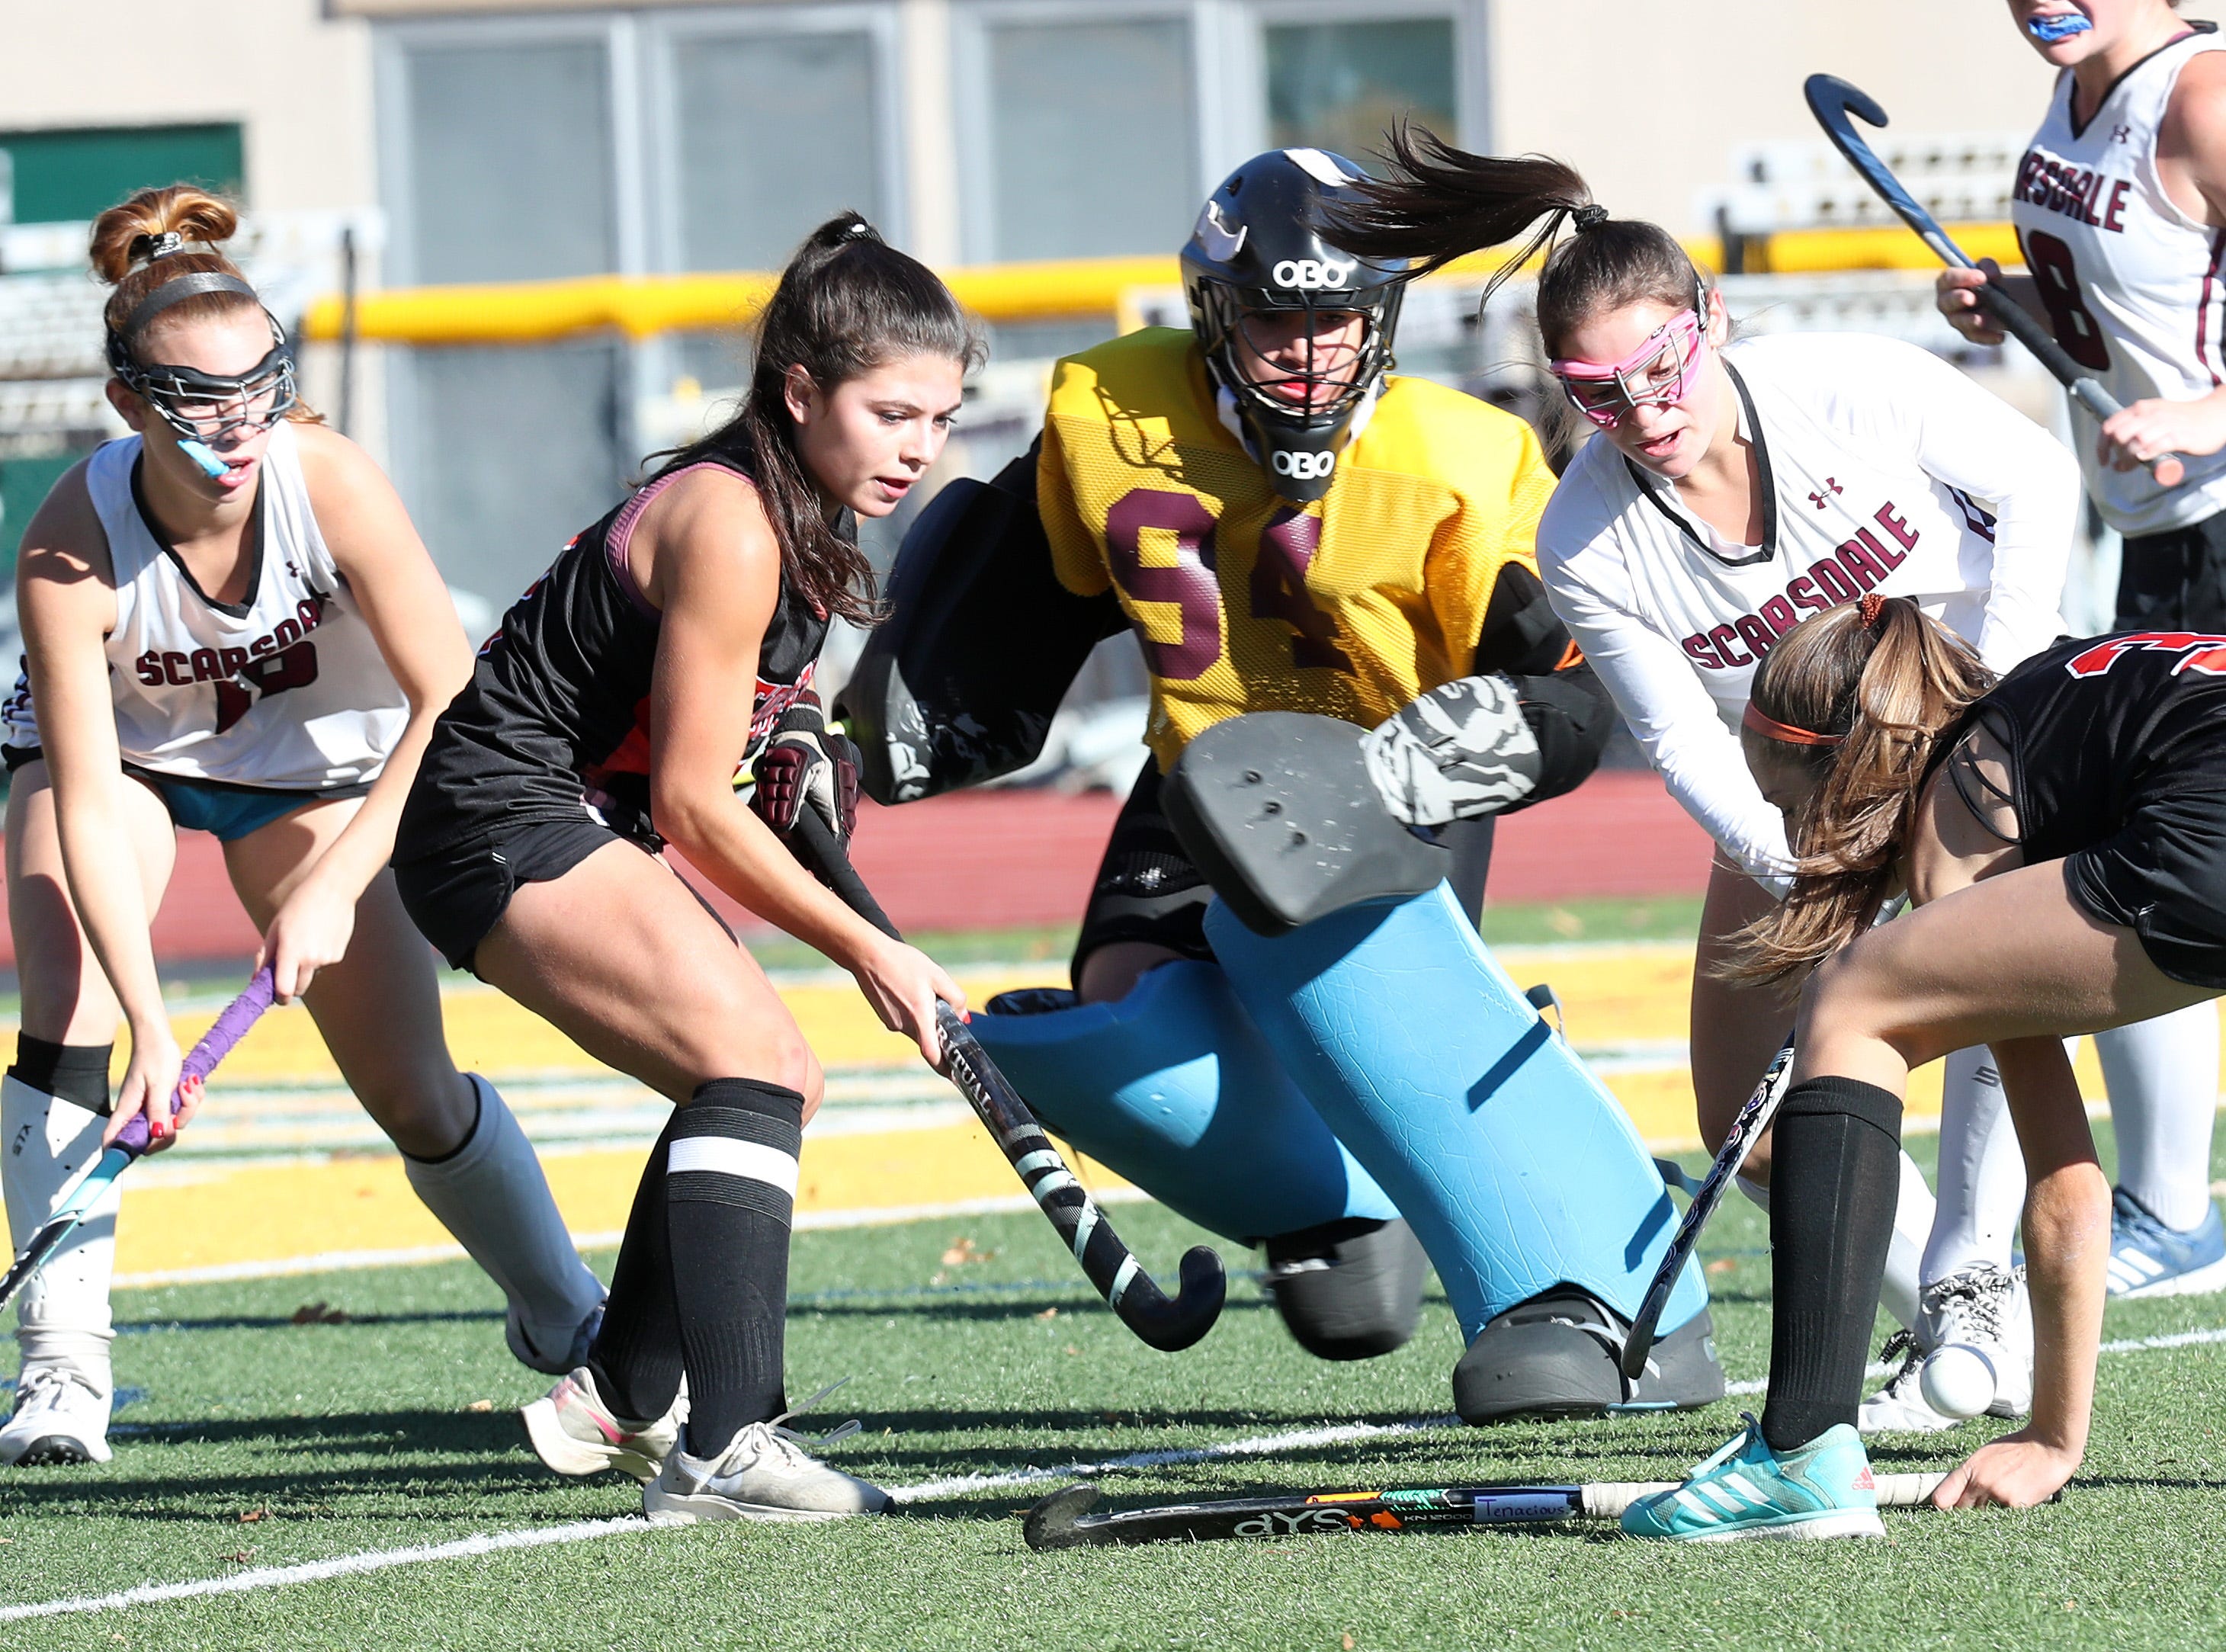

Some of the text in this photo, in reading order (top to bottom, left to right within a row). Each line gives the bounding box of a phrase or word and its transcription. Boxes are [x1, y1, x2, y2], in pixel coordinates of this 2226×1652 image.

[1272, 259, 1348, 289] OBO
[1272, 450, 1336, 480] OBO
[1105, 487, 1358, 681] 94
[1682, 500, 1920, 669] SCARSDALE
[937, 1023, 992, 1115] RITUAL
